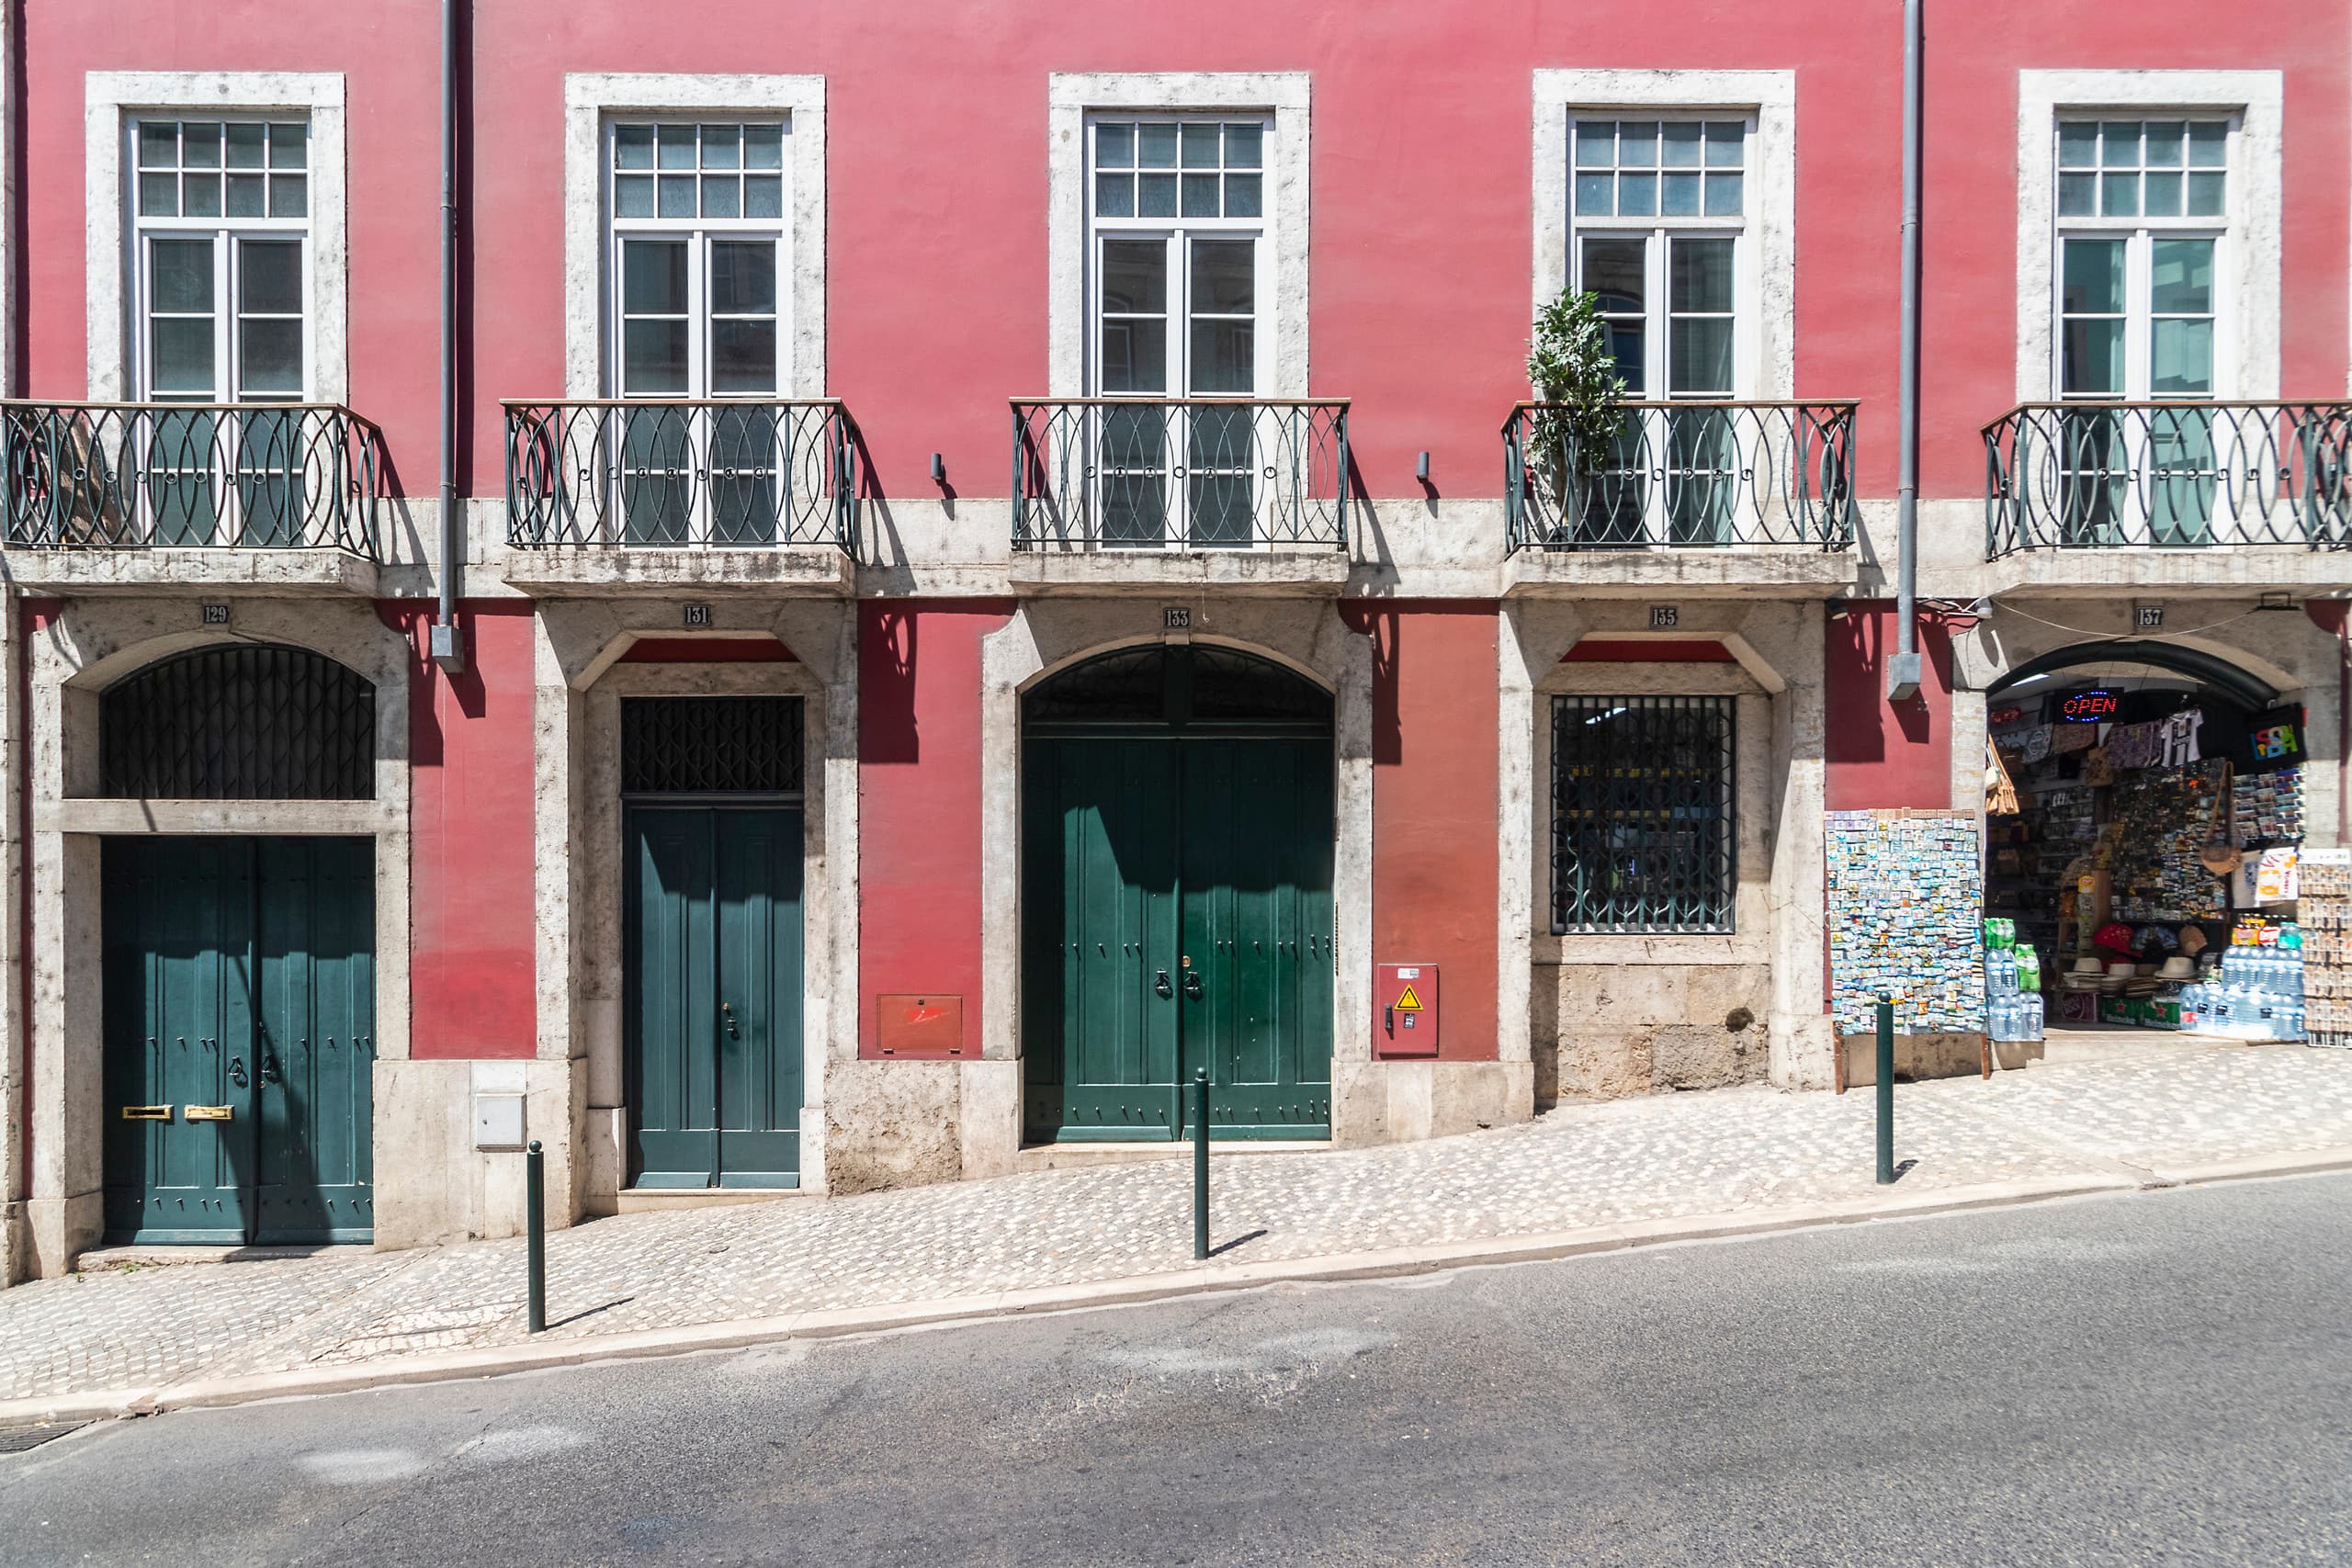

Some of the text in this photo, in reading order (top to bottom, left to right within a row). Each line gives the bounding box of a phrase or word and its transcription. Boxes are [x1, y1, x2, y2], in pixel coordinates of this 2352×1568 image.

[205, 606, 227, 623] 129
[686, 607, 707, 623] 131
[1167, 610, 1189, 626] 133
[1653, 609, 1675, 625] 135
[2138, 609, 2161, 626] 137
[2063, 698, 2118, 714] OPEN
